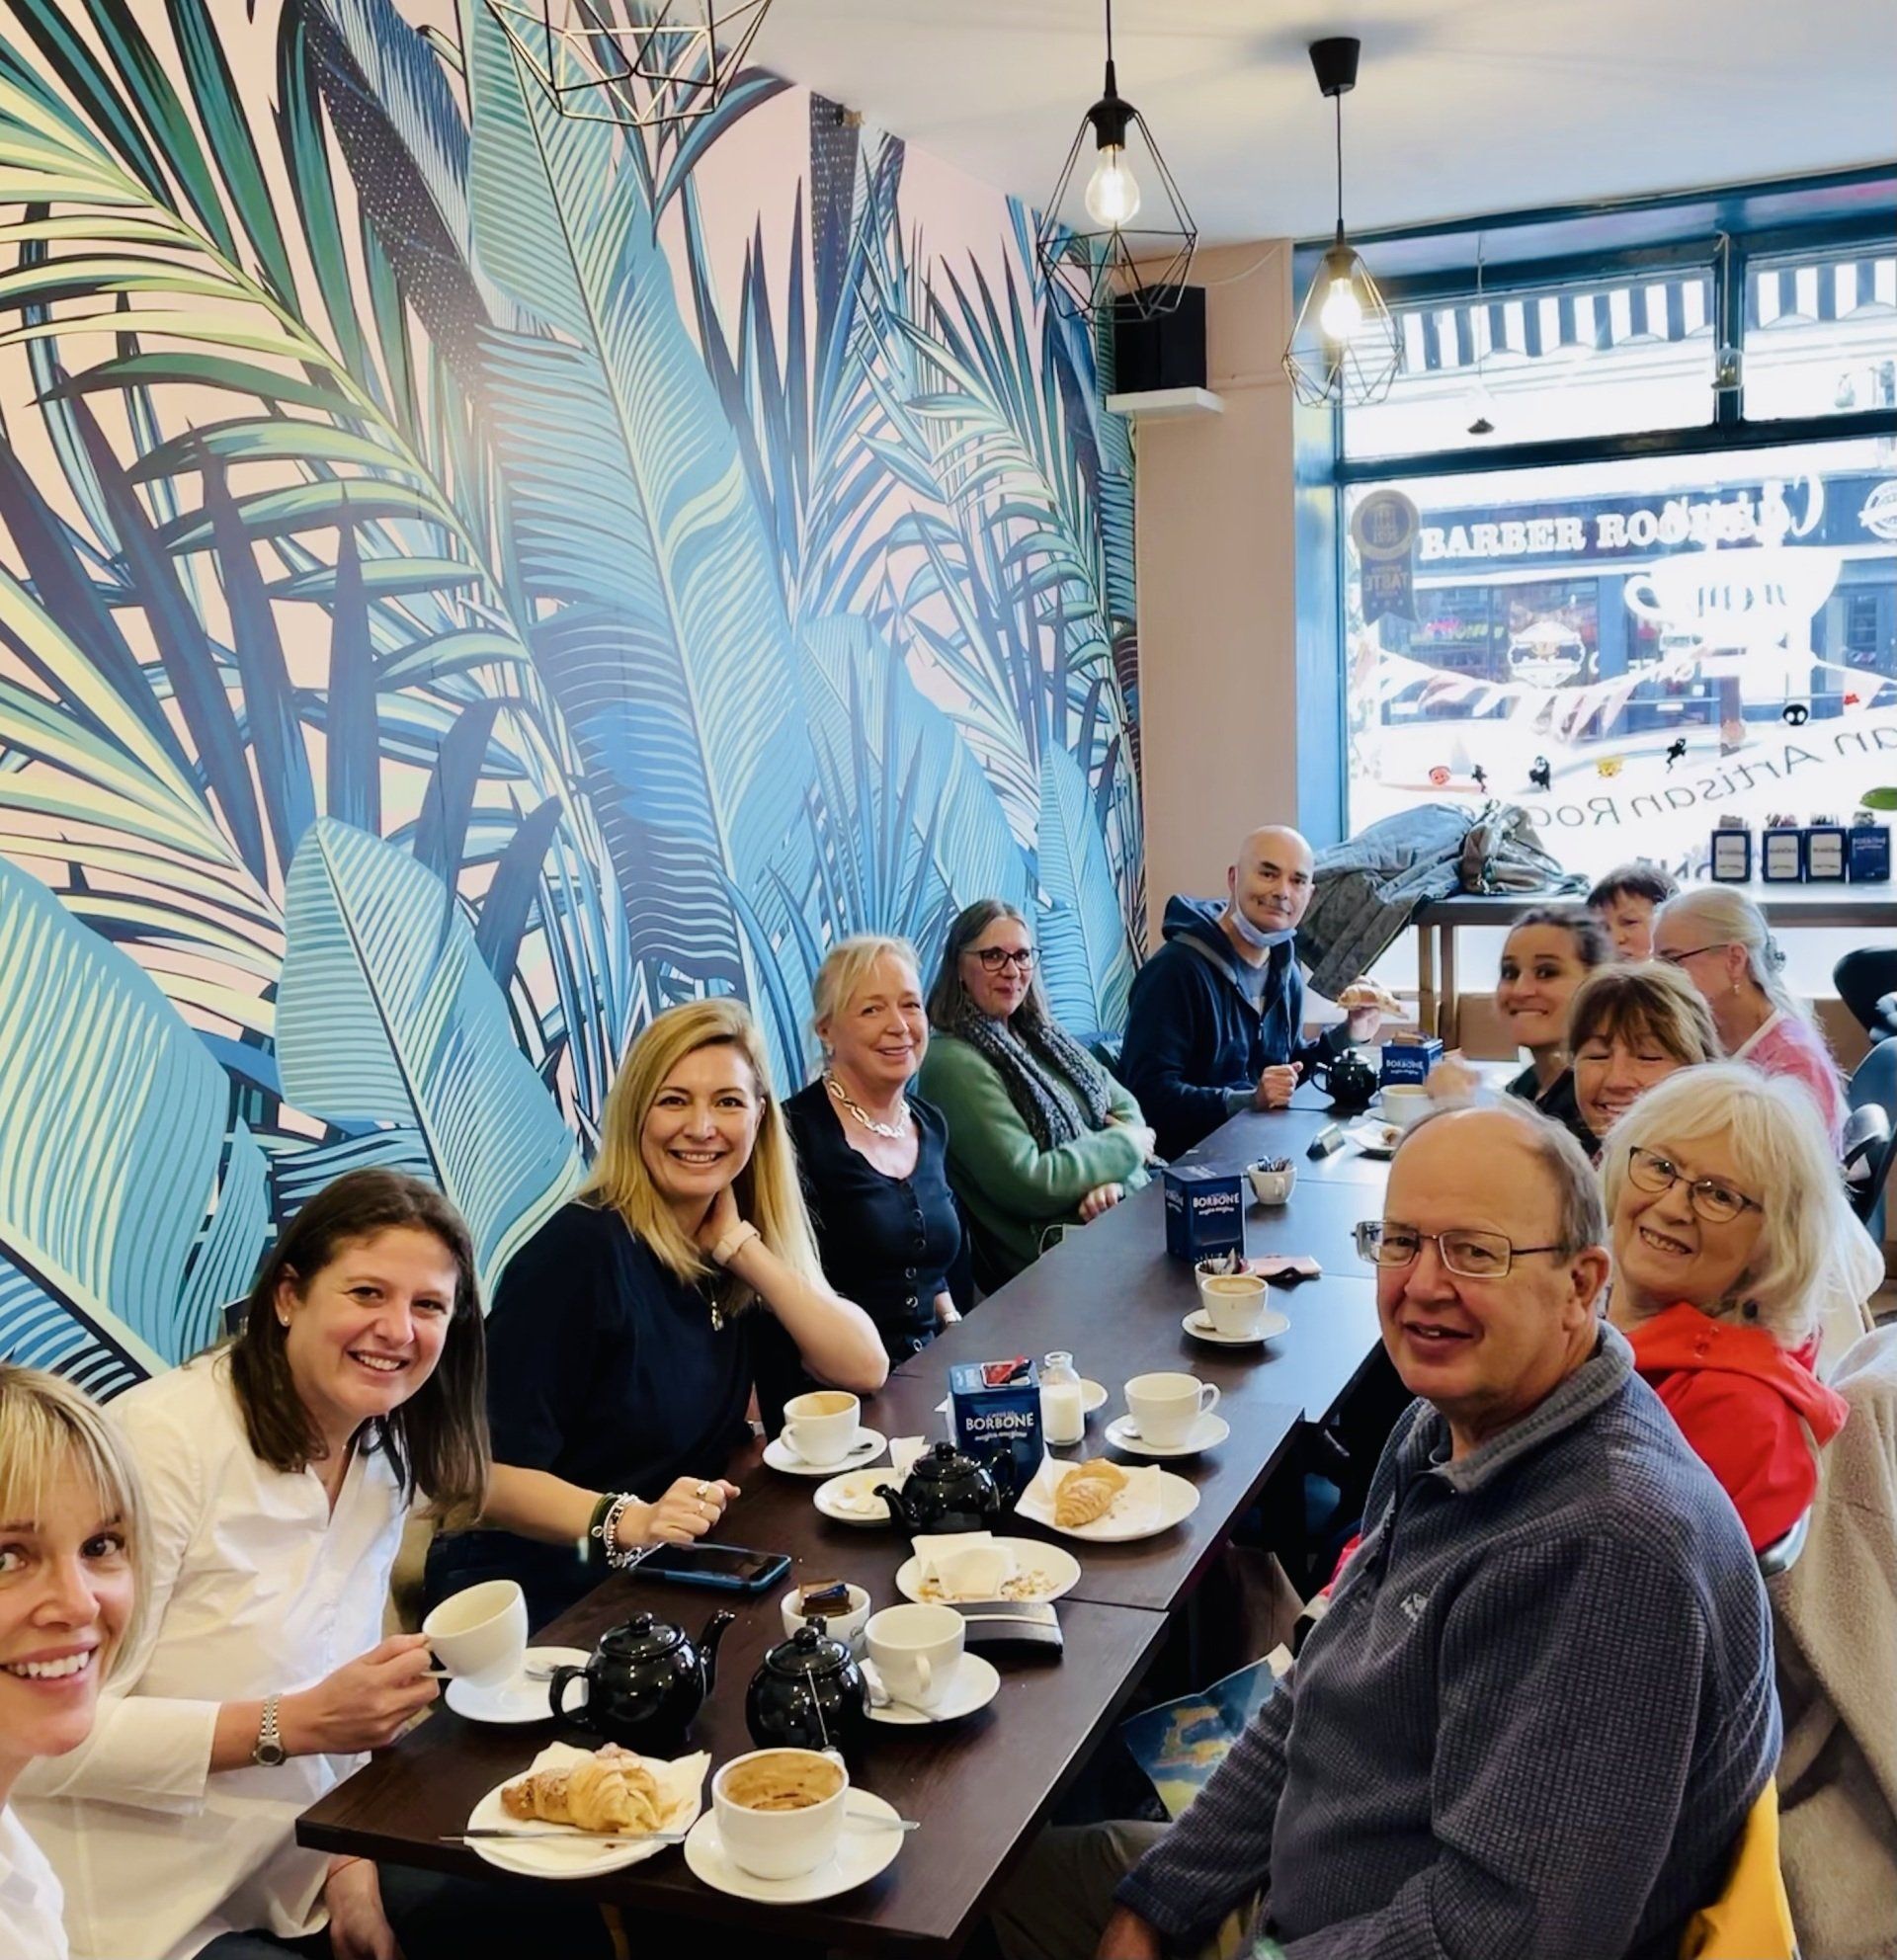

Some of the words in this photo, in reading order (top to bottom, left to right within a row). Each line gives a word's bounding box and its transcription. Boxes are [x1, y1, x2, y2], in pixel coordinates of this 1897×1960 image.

[1419, 517, 1587, 560] BARBER
[1193, 1192, 1240, 1208] BORBONE
[965, 1412, 1034, 1431] BORBONE
